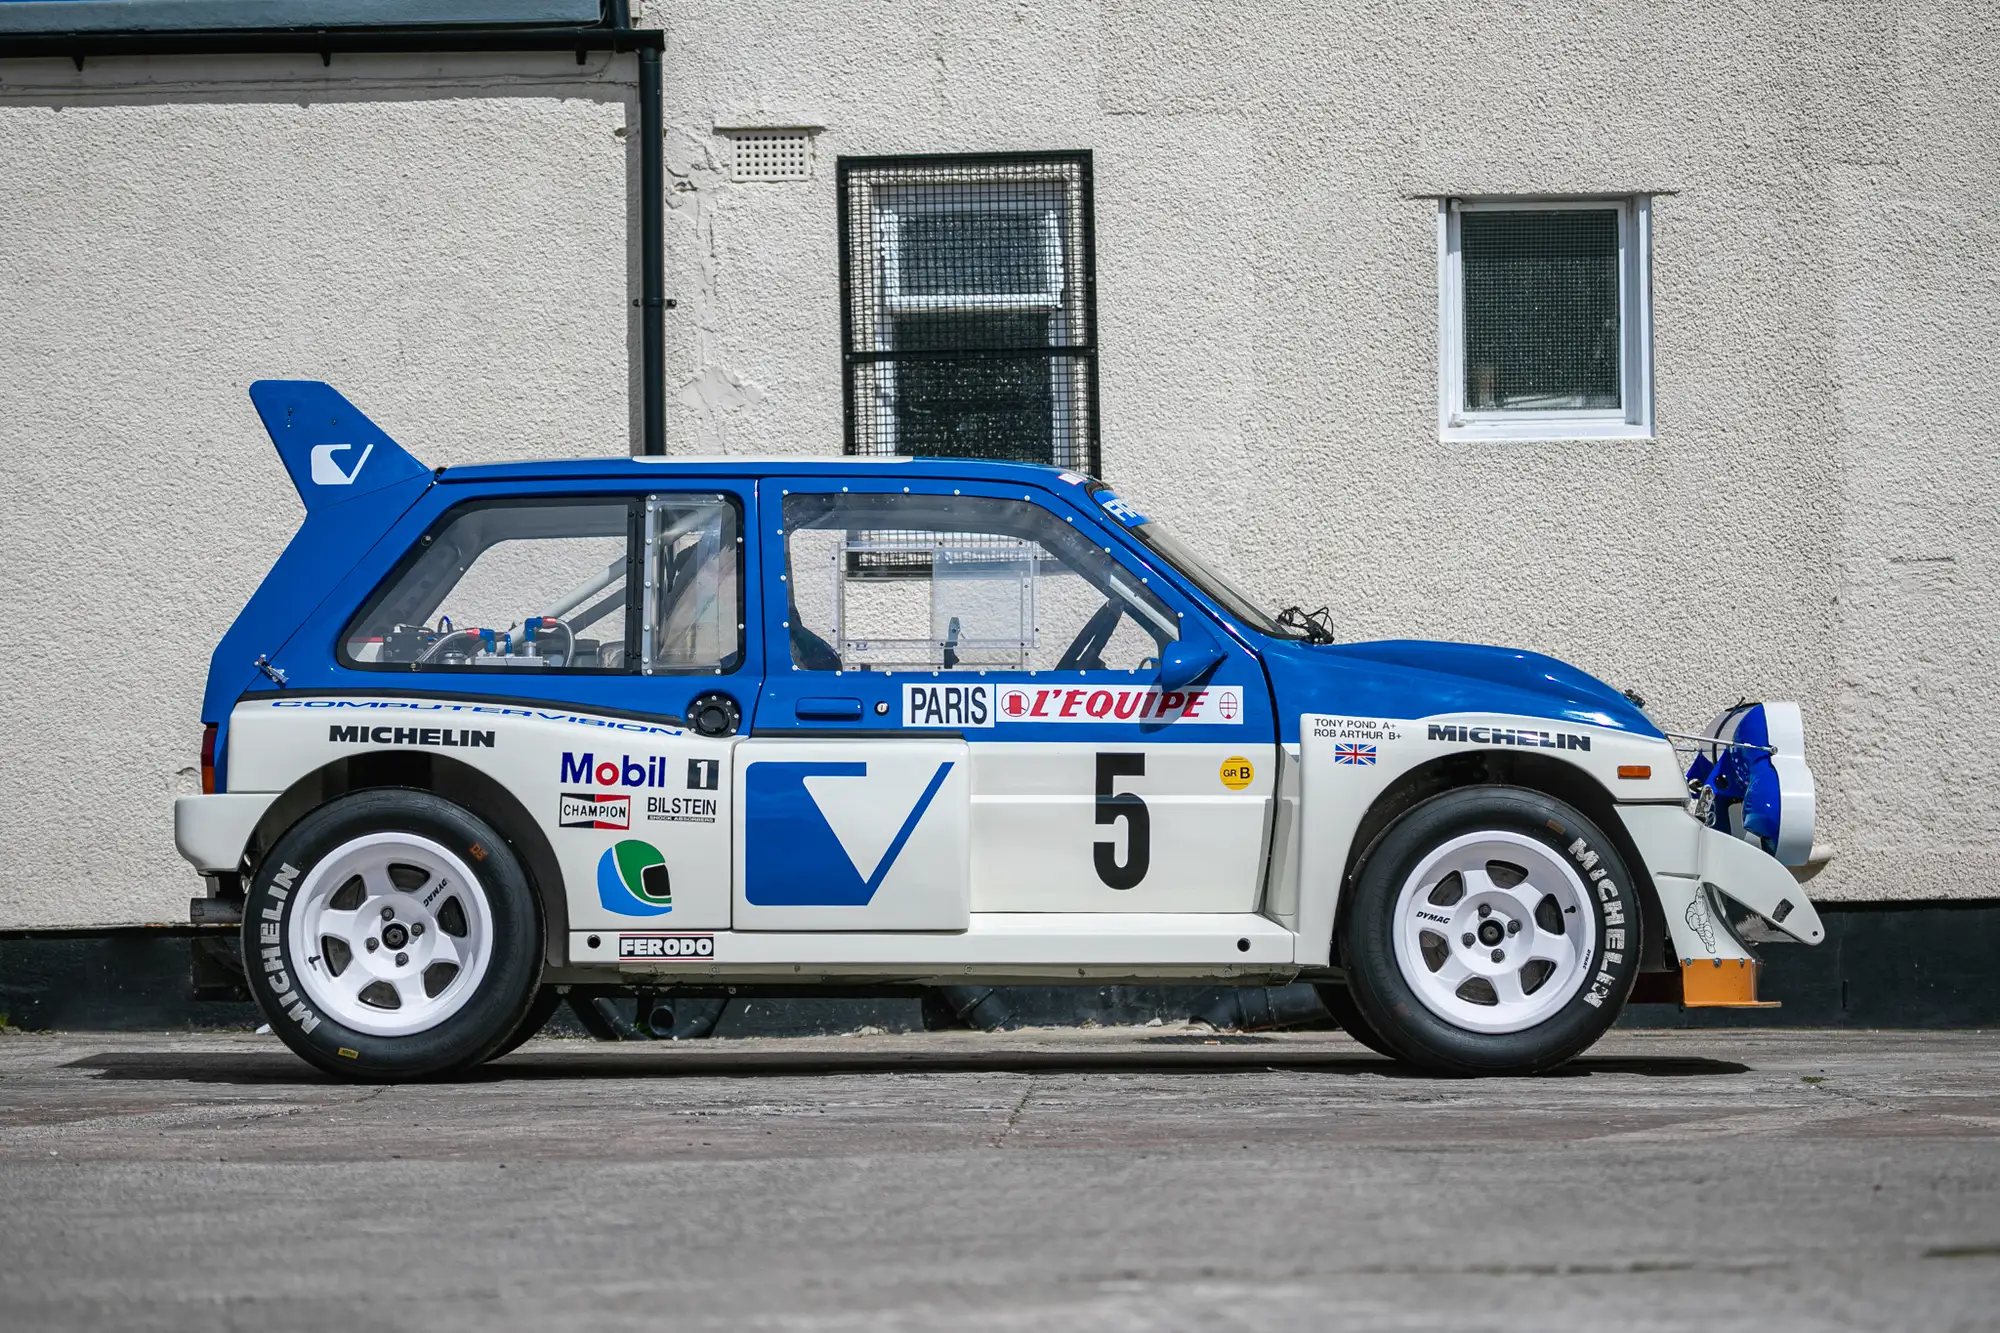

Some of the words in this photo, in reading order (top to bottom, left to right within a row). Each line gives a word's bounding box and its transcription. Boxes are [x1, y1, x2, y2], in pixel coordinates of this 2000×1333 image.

[911, 687, 988, 725] PARIS
[272, 701, 683, 736] COMPUTERVISION
[1315, 719, 1344, 728] TONY
[1347, 720, 1376, 729] POND
[1382, 722, 1396, 730] A+
[329, 725, 495, 748] MICHELIN
[1314, 729, 1337, 738] ROB
[1340, 730, 1384, 740] ARTHUR
[1388, 732, 1402, 740] B+
[1427, 725, 1592, 751] MICHELIN
[561, 752, 666, 787] Mobil
[1223, 768, 1237, 777] GR
[1239, 767, 1251, 779] B
[564, 804, 626, 818] CHAMPION
[648, 797, 716, 815] BILSTEIN
[1093, 752, 1150, 890] 5
[1415, 911, 1451, 924] DYMAG
[260, 862, 321, 1035] MICHELIN
[620, 938, 714, 958] FERODO
